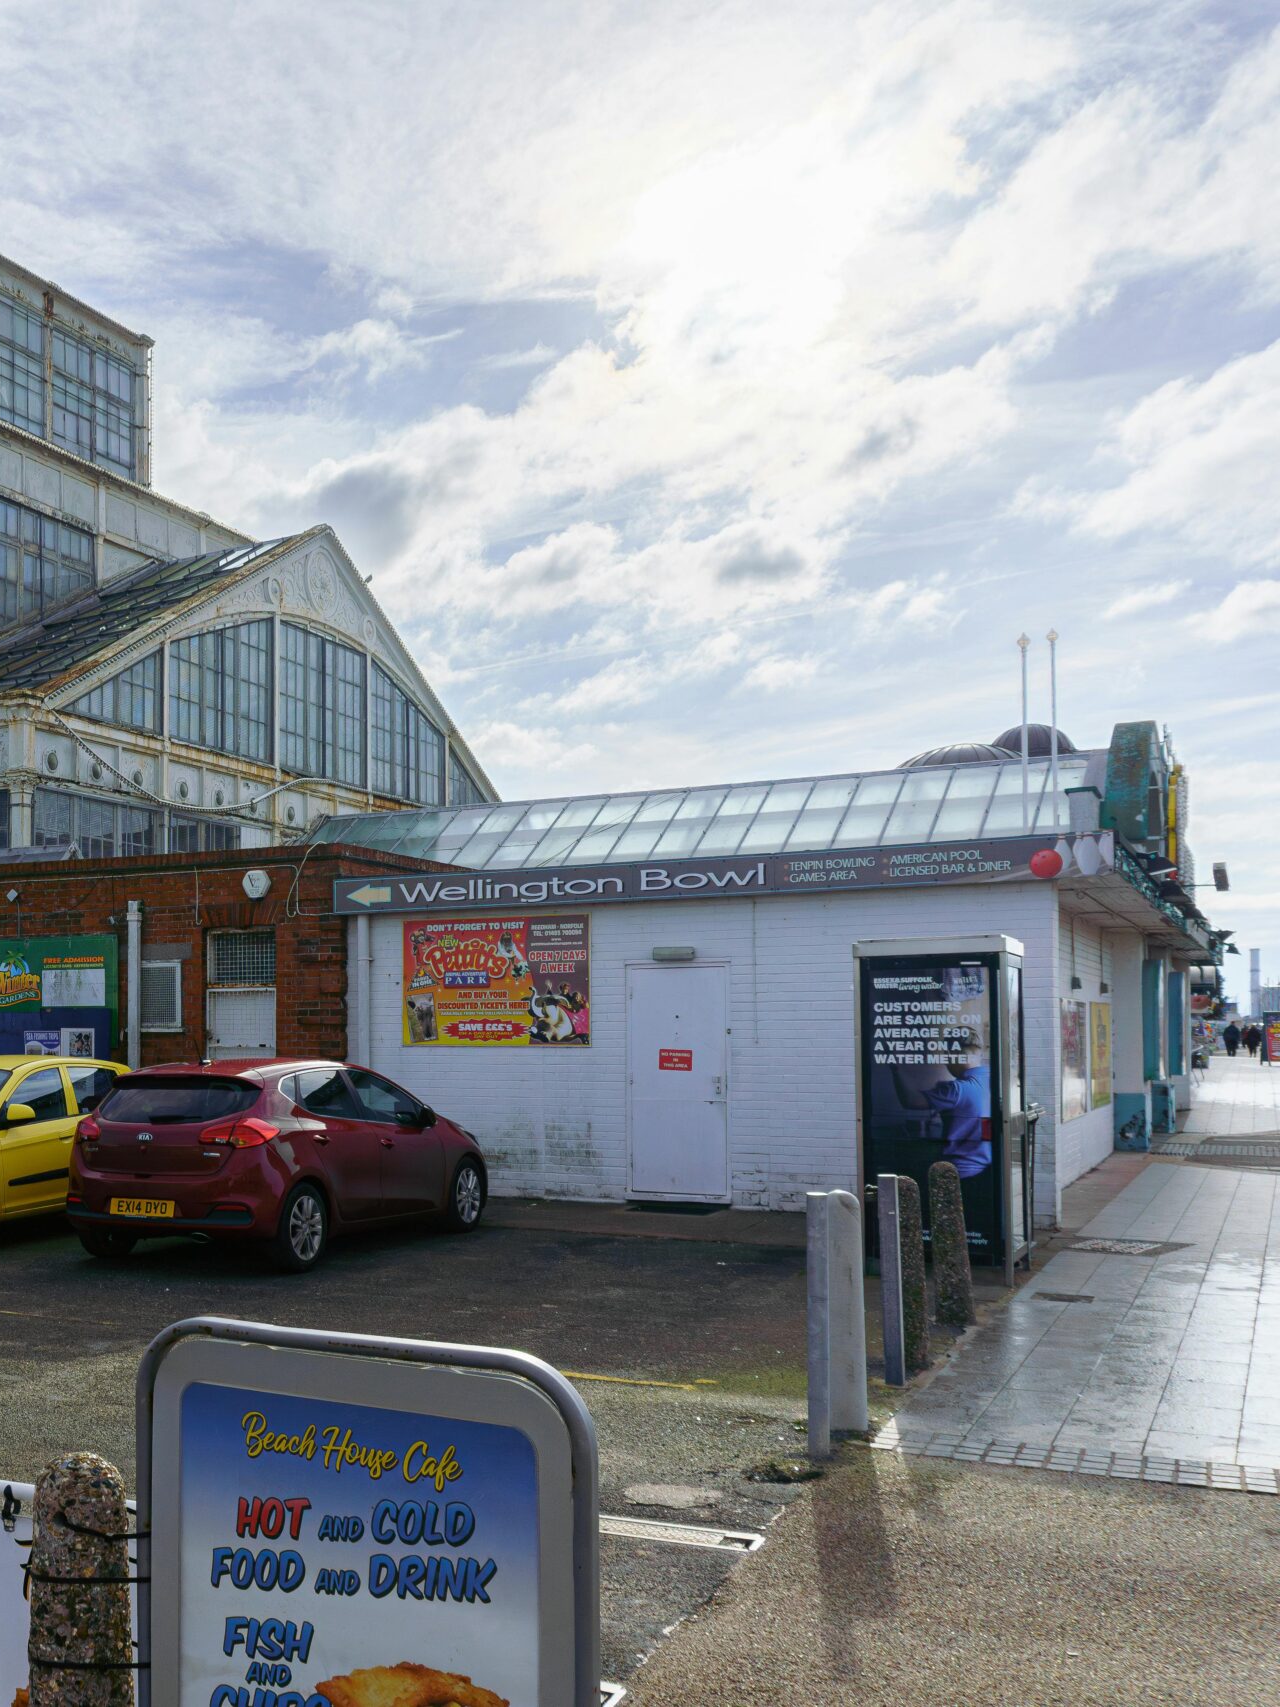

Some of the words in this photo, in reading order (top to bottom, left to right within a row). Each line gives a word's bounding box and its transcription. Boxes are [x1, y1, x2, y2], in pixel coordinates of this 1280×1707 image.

[889, 852, 948, 865] AMERICAN
[950, 849, 983, 861] POOL
[789, 860, 824, 871] TENPIN
[826, 857, 876, 869] BOWLING
[889, 865, 940, 877] LICENSED
[942, 863, 966, 874] BAR
[967, 862, 977, 872] &
[978, 860, 1012, 872] DINER
[789, 872, 829, 883] GAMES
[829, 871, 858, 881] AREA
[399, 876, 623, 904] Wellington
[640, 862, 765, 891] Bowl
[426, 923, 452, 932] DON'T
[453, 922, 487, 931] FORGET
[488, 922, 500, 930] TO
[502, 921, 525, 929] VISIT
[438, 939, 459, 947] NEW
[529, 950, 553, 961] OPEN
[555, 950, 561, 961] 7
[562, 950, 586, 961] DAYS
[540, 963, 547, 973] A
[548, 962, 575, 973] WEEK
[445, 976, 487, 985] PARK
[898, 983, 921, 993] living
[921, 981, 944, 990] water
[457, 991, 472, 999] AND
[437, 1001, 479, 1010] DISCOUNTED
[480, 1001, 507, 1009] TICKETS
[508, 1001, 530, 1009] HERE!
[873, 1001, 961, 1012] CUSTOMERS
[873, 1015, 902, 1025] ARE
[905, 1014, 957, 1025] SAVING
[961, 1014, 981, 1025] ON
[458, 1023, 482, 1031] SAVE
[873, 1027, 940, 1038] AVERAGE
[943, 1027, 970, 1038] £80
[874, 1041, 884, 1051] A
[887, 1041, 924, 1051] YEAR
[927, 1041, 948, 1051] ON
[951, 1041, 961, 1051] A
[874, 1054, 927, 1064] WATER
[138, 1133, 151, 1141] KIA
[117, 1200, 142, 1213] EX14
[145, 1202, 168, 1214] DYO
[241, 1411, 318, 1460] Beach
[321, 1426, 399, 1480] House
[402, 1441, 463, 1492] Cafe
[236, 1496, 312, 1541] HOT
[318, 1515, 365, 1543] AND
[371, 1499, 476, 1548] COLD
[210, 1546, 306, 1593] FOOD
[314, 1568, 361, 1596] AND
[368, 1554, 498, 1604] DRINK
[223, 1616, 315, 1664] FISH
[245, 1661, 292, 1688] AND
[210, 1684, 333, 1707] CHI
